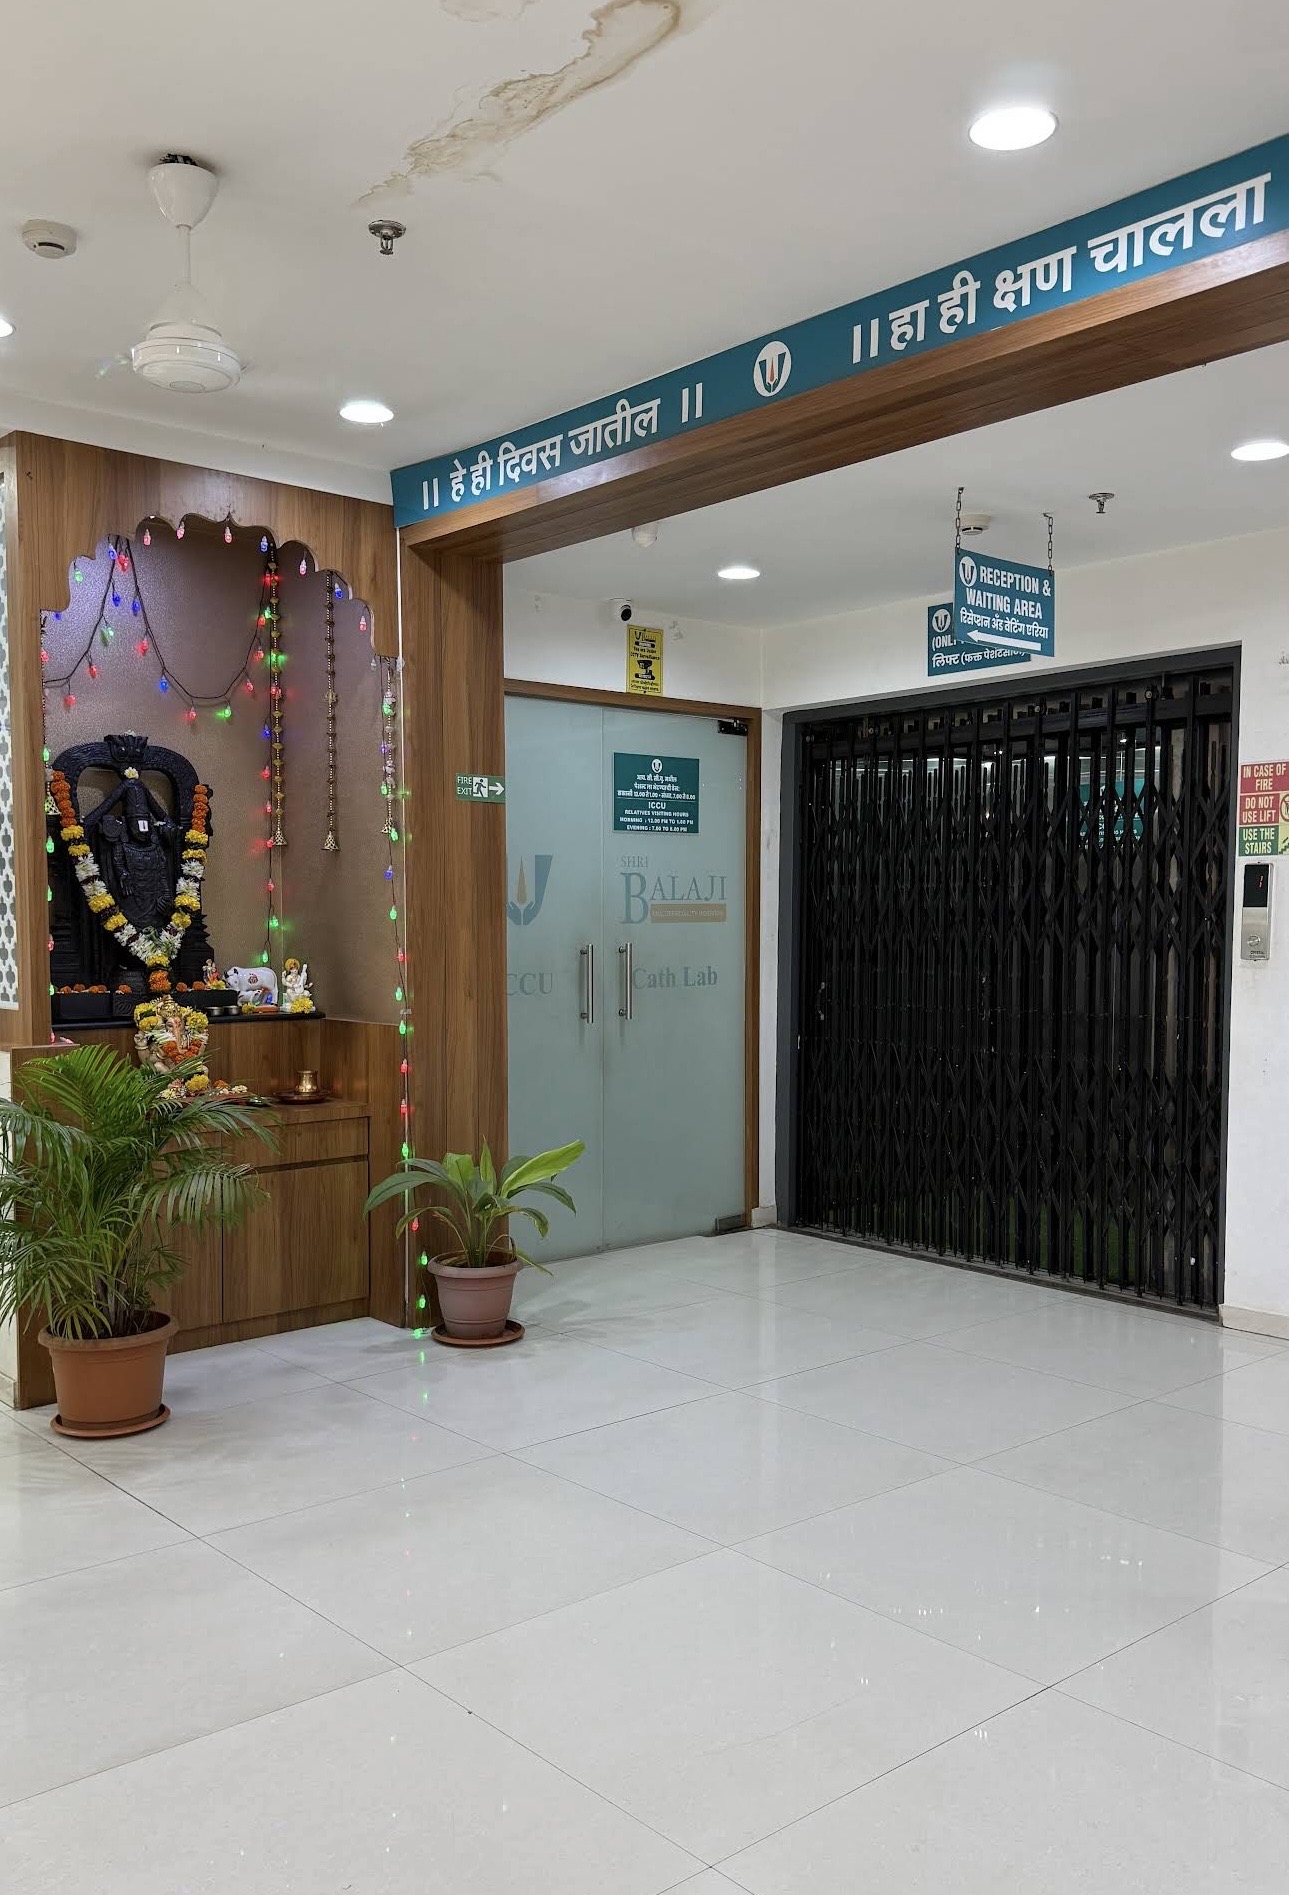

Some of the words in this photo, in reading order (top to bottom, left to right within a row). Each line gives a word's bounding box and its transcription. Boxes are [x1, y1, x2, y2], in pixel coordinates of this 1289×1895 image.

[889, 299, 930, 351] हा
[938, 270, 980, 334] ही
[992, 246, 1077, 312] क्षण
[1088, 172, 1271, 273] चालला
[450, 460, 467, 502] हे
[471, 450, 492, 496] ही
[498, 434, 563, 486] दिवस
[568, 398, 661, 457] जातील
[980, 565, 1039, 594] RECEPTION
[1042, 580, 1052, 597] &
[966, 587, 1011, 614] WAITING
[1013, 599, 1043, 619] AREA
[960, 607, 991, 629] रिसेप्शन
[1004, 619, 1025, 636] वेटिंग
[1026, 622, 1049, 639] एरिया
[1243, 764, 1251, 778] IN
[1253, 763, 1275, 777] CASE
[1276, 762, 1287, 776] OF
[457, 776, 472, 784] FIRE
[1255, 778, 1273, 791] FIRE
[457, 787, 472, 795] EXIT
[648, 801, 666, 810] ICCU
[1245, 797, 1257, 809] DO
[1258, 795, 1274, 808] NOT
[1242, 811, 1257, 823] USE
[1259, 809, 1276, 822] LIFT
[1243, 829, 1257, 841] USE
[1259, 827, 1275, 840] THE
[1246, 841, 1272, 855] STAIRS
[620, 855, 648, 869] SHRI
[617, 871, 728, 925] BALAJI
[633, 966, 676, 990] Cath
[683, 965, 718, 988] Lab
